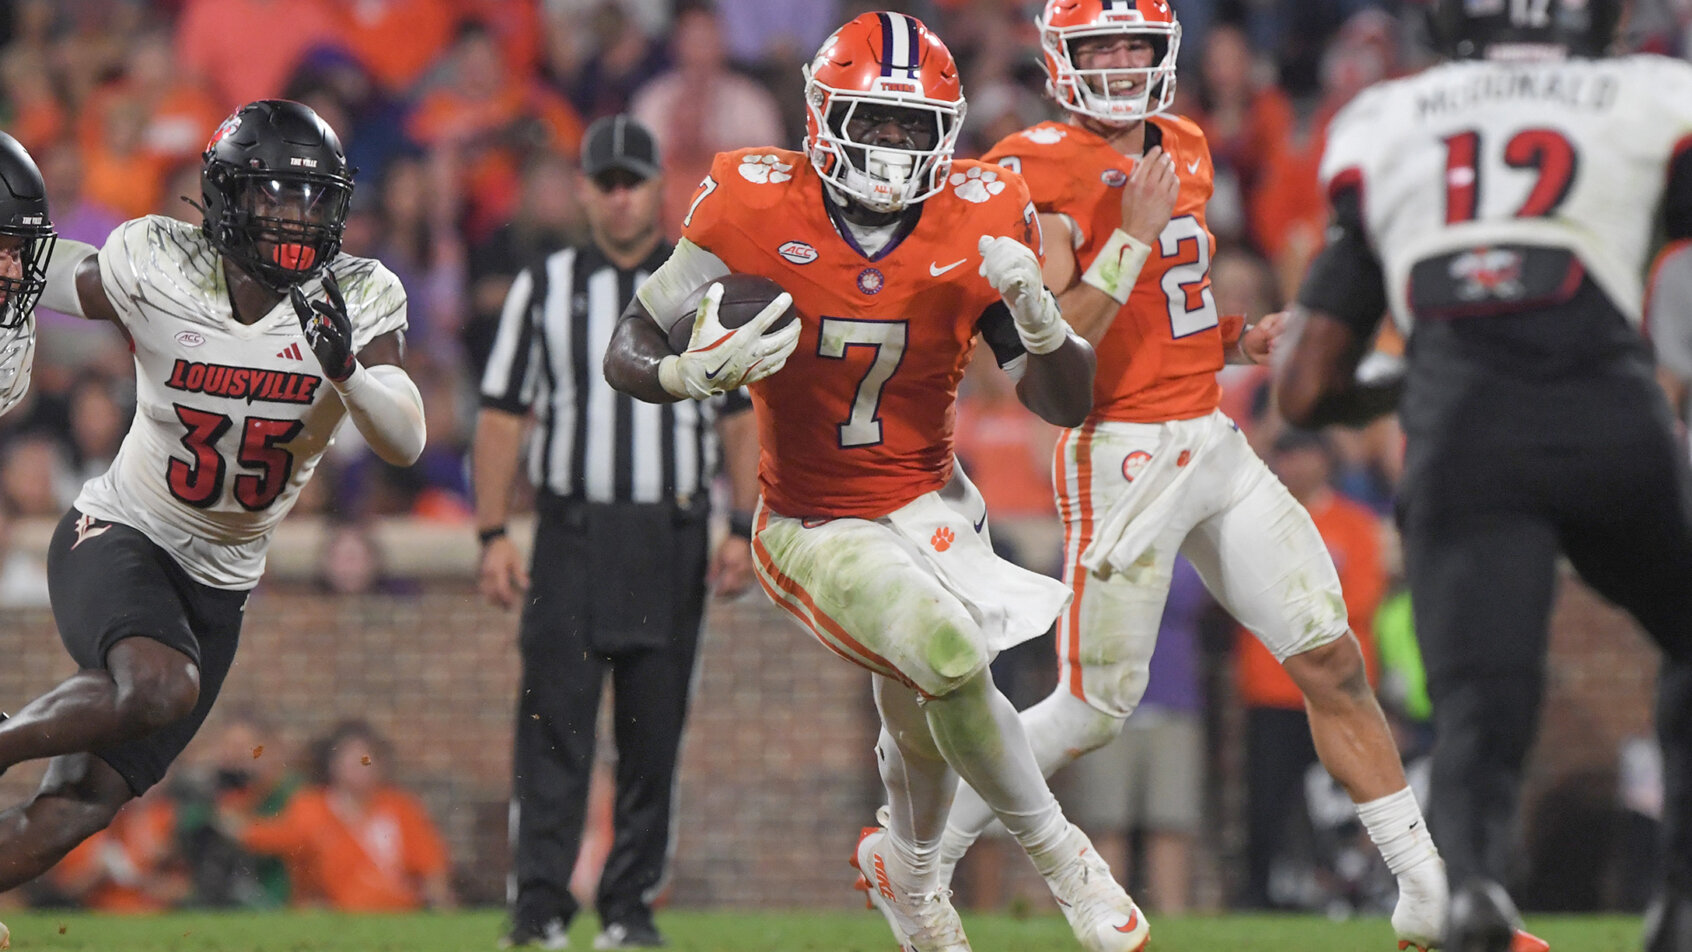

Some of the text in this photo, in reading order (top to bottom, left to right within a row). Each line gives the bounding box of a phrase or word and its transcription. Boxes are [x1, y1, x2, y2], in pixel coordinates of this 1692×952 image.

[683, 174, 719, 228] 7
[1437, 126, 1579, 226] 12
[784, 245, 814, 258] ACC
[1023, 199, 1044, 256] 7
[1158, 213, 1219, 340] 2
[178, 333, 200, 344] ACC
[165, 358, 322, 405] LOUISVILLE
[816, 315, 909, 449] 7
[166, 402, 304, 511] 35
[873, 853, 897, 903] NIKE
